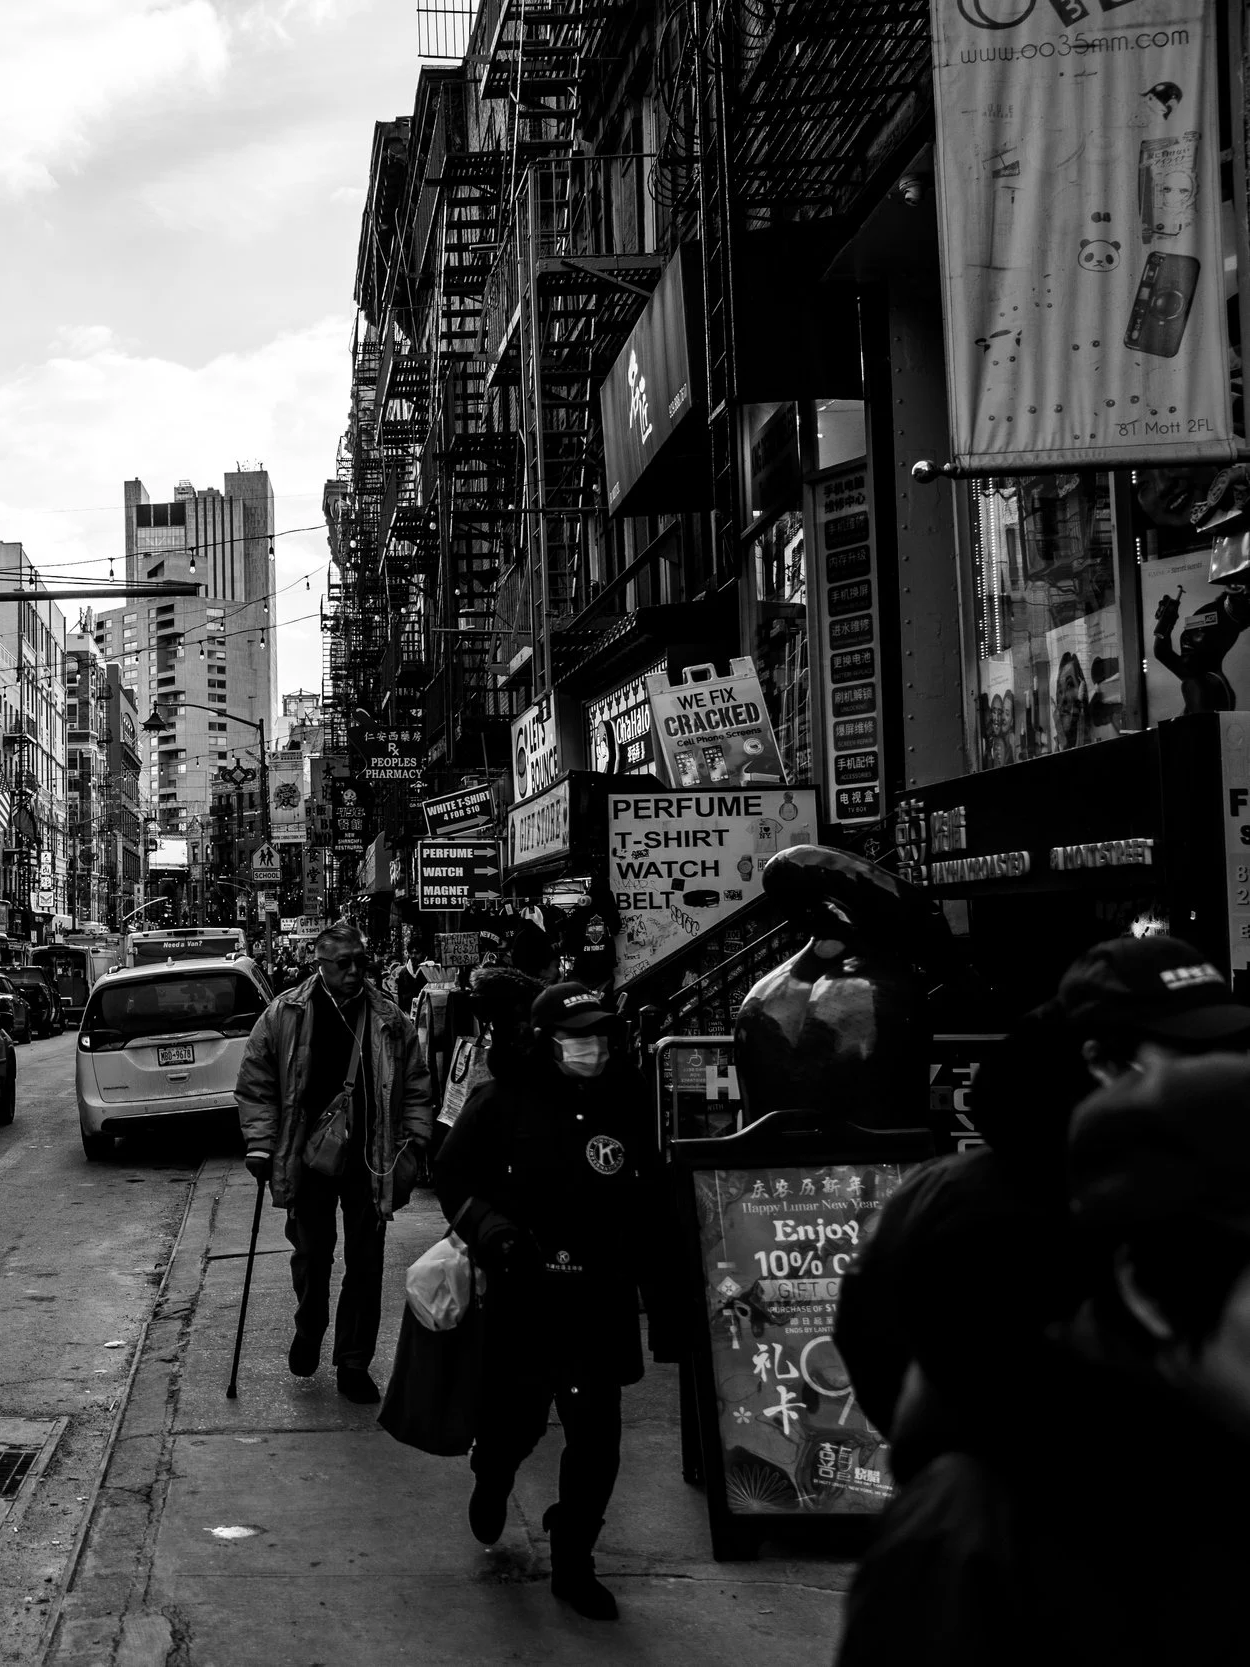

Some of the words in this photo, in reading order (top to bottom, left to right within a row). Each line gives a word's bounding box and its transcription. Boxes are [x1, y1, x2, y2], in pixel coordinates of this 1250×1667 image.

[961, 29, 1189, 63] www.oo35mm.com
[1119, 423, 1136, 437] 81
[1145, 421, 1181, 435] Mott
[1188, 418, 1214, 433] 2FL
[831, 584, 869, 604] 手机换屏
[832, 618, 870, 638] 进水维修
[833, 651, 871, 670] 更换电池
[677, 692, 707, 711] WE
[709, 687, 737, 705] FIX
[834, 687, 873, 705] 刷机解锁
[664, 702, 761, 737] CRACKED
[836, 721, 874, 736] 爆屏维修
[677, 739, 695, 747] Cell
[696, 734, 725, 743] Phone
[725, 727, 762, 739] Screens
[371, 758, 417, 767] PEOPLES
[531, 745, 558, 794] BOUNCE
[837, 756, 875, 771] 手机配件
[365, 769, 423, 779] PHARMACY
[427, 800, 457, 816] WHITE
[456, 791, 490, 808] T-SHIRT
[613, 795, 763, 819] PERFUME
[840, 790, 874, 805] 电视盒
[450, 809, 465, 819] FOR
[466, 805, 480, 815] $10
[520, 812, 535, 853] GIFT
[537, 799, 561, 848] STORE
[614, 829, 729, 849] T-SHIRT
[422, 848, 473, 859] PERFUME
[423, 867, 464, 877] WATCH
[616, 860, 720, 879] WATCH
[423, 885, 469, 896] MAGNET
[616, 892, 675, 910] BELT
[599, 1143, 615, 1166] K
[751, 1176, 865, 1199] 庆农历新年
[742, 1202, 781, 1216] Happy
[784, 1201, 819, 1212] Lunar
[822, 1199, 850, 1210] New
[851, 1199, 880, 1210] Year
[772, 1218, 860, 1256] Enjoy
[754, 1249, 824, 1277] 10%
[777, 1281, 820, 1299] GIFT
[769, 1305, 811, 1314] PURCHASE
